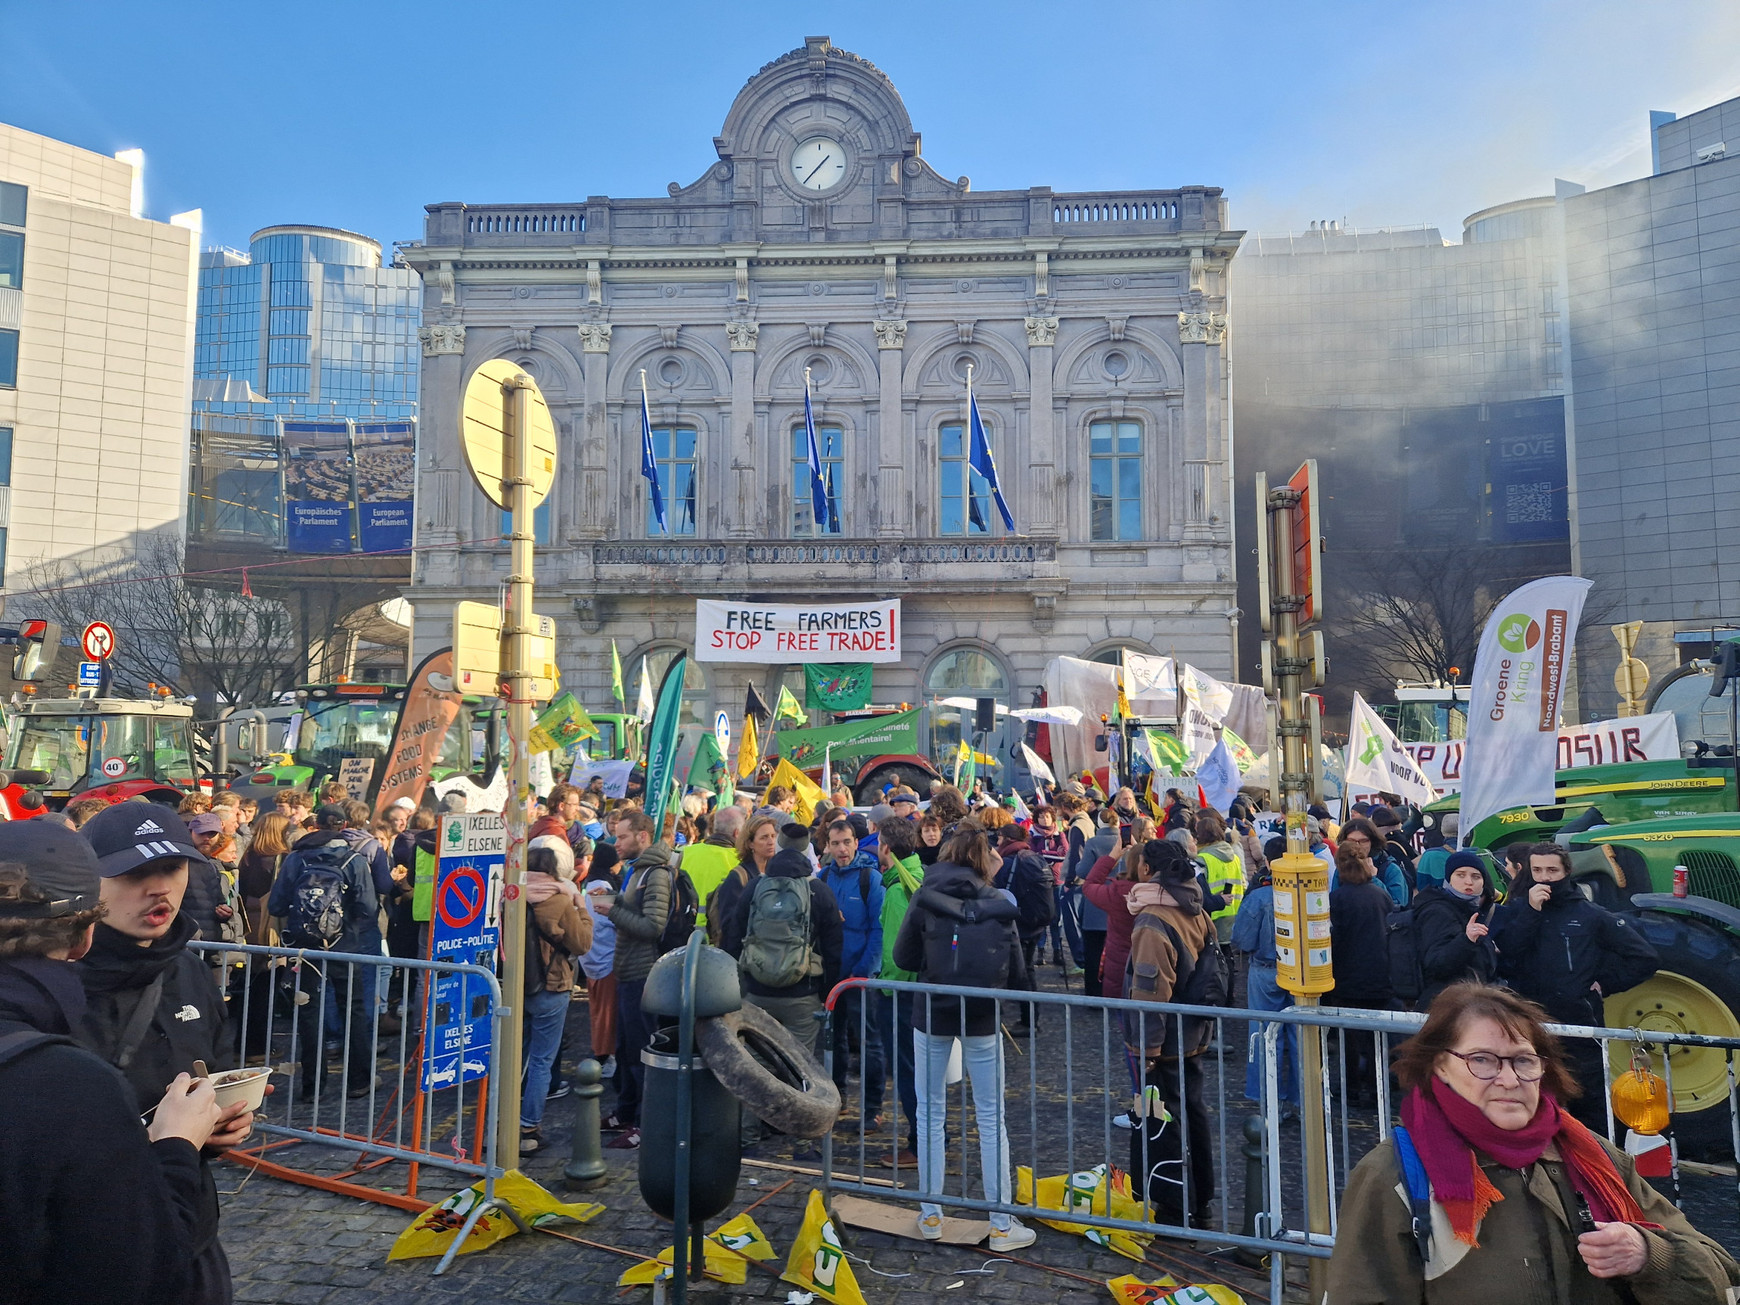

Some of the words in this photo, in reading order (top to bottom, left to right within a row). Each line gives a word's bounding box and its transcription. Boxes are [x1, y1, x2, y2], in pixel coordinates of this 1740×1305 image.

[1500, 440, 1556, 458] LOVE
[295, 507, 342, 516] Europäisches
[373, 508, 405, 517] European
[299, 517, 338, 526] Parlament
[371, 518, 408, 527] Parliament
[726, 611, 776, 631] FREE
[799, 610, 882, 631] FARMERS
[711, 630, 761, 650] STOP
[777, 631, 819, 651] FREE
[1543, 615, 1563, 728] Noordwest-Brabant
[1510, 661, 1535, 703] Kring
[1489, 659, 1511, 721] Groene
[396, 743, 422, 764] FOOD
[1555, 728, 1648, 770] OSUR
[106, 763, 119, 771] 40
[1390, 761, 1411, 781] VOOR
[380, 763, 423, 793] SYSTEMS
[1650, 781, 1674, 789] JOHN
[469, 816, 505, 831] IXELLES
[1499, 812, 1529, 824] 7930
[134, 828, 164, 836] adidas
[1643, 833, 1674, 841] 6320
[468, 837, 503, 852] ELSENE
[437, 934, 495, 951] POLICE-POLITIE
[438, 982, 452, 991] partir
[445, 1024, 473, 1039] IXELES
